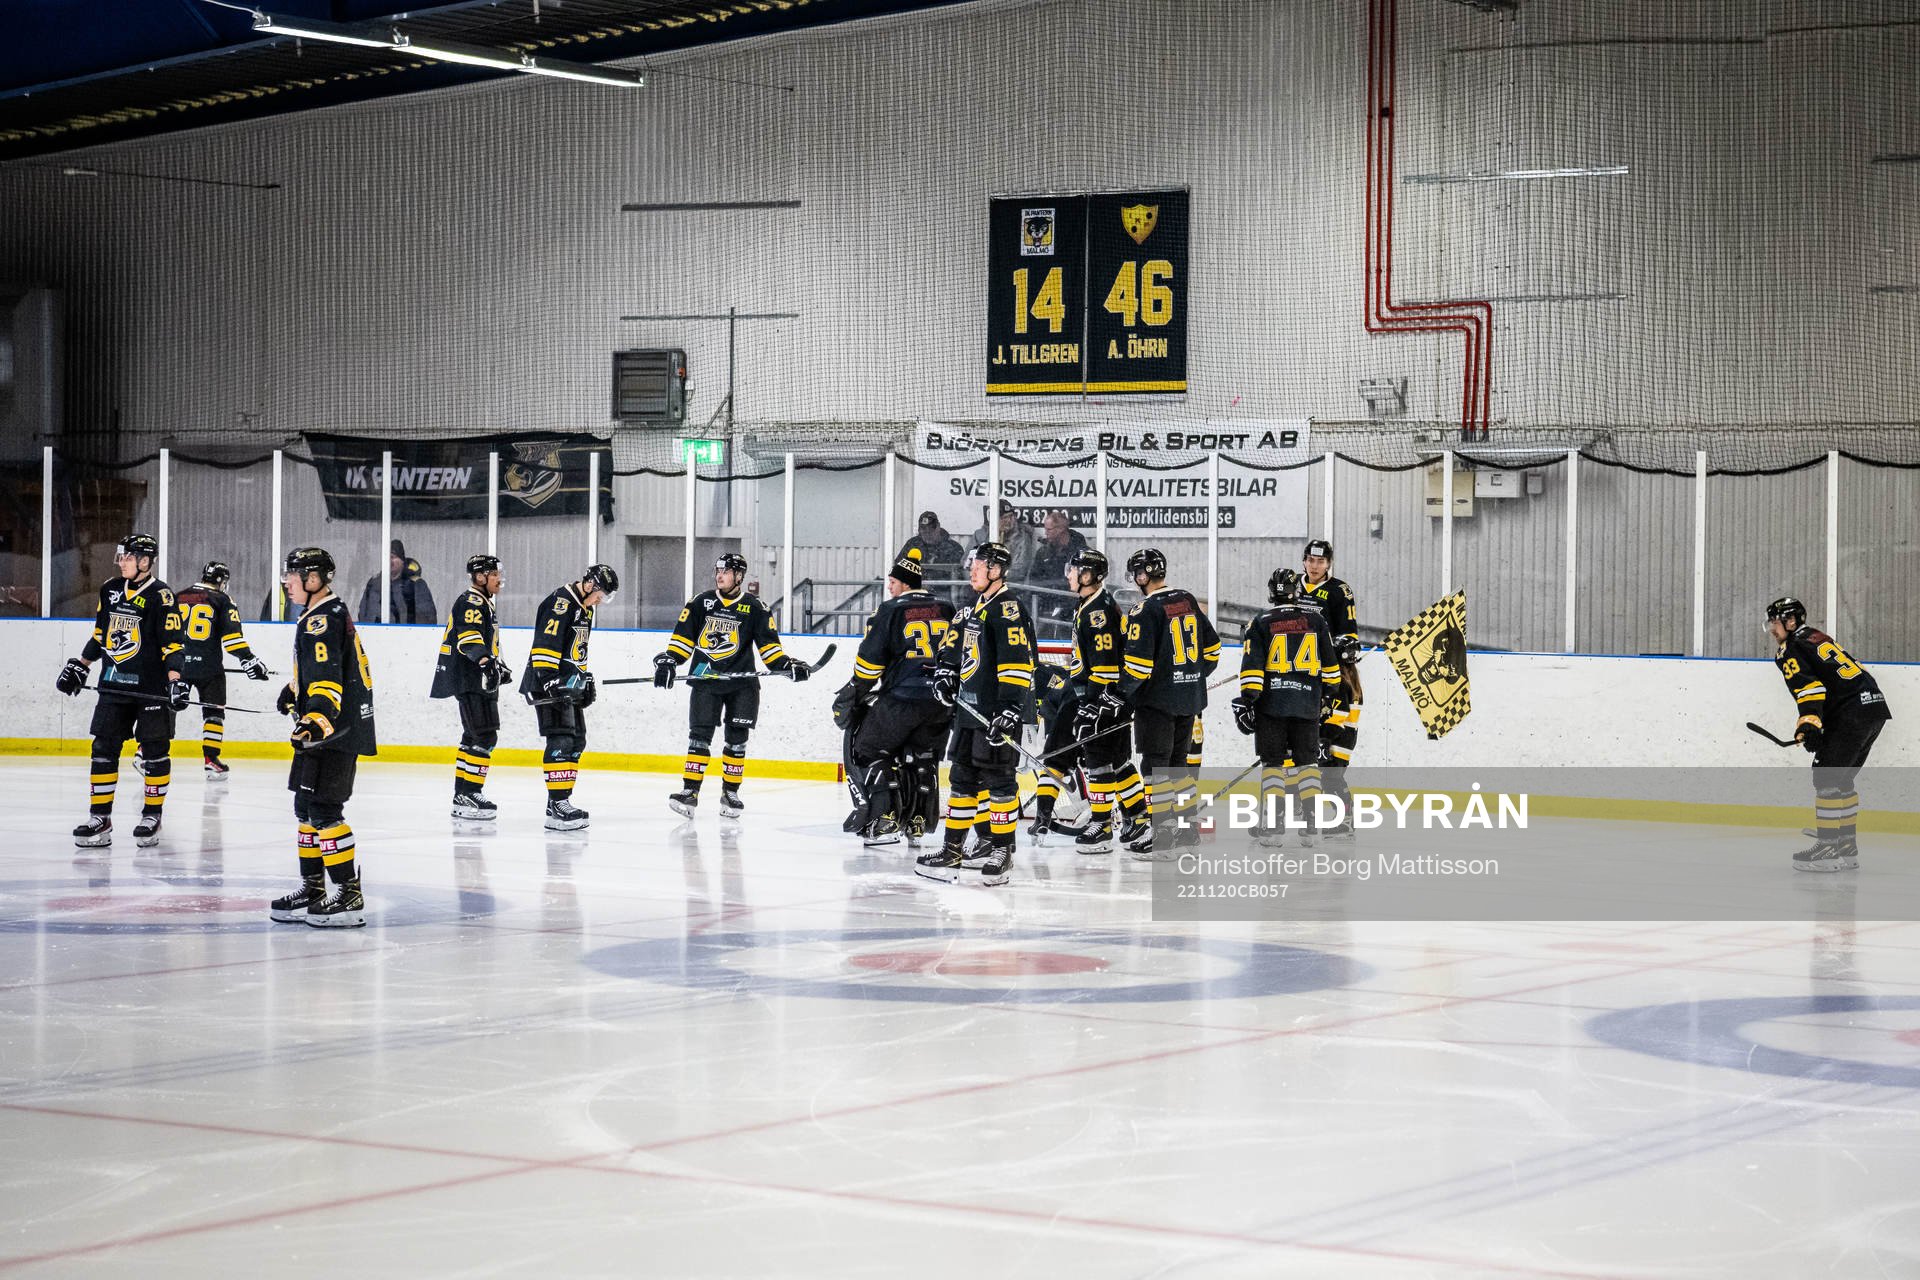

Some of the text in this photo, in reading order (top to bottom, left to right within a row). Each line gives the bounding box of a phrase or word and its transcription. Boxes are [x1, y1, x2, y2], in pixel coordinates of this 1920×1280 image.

[1013, 267, 1065, 334] 14
[1103, 260, 1174, 326] 46
[993, 343, 1079, 365] J. TILLGREN
[1107, 333, 1168, 359] A. ÖHRN
[1099, 432, 1136, 451] BIL
[1140, 432, 1159, 451] &
[1165, 432, 1250, 450] SPORT
[1257, 430, 1299, 449] AB
[1067, 458, 1147, 468] STAFFNSTORP
[1106, 477, 1278, 497] KVALITETSBILAR
[1081, 508, 1233, 528] ww.bjorklidensbise
[165, 613, 181, 631] 50
[464, 609, 483, 625] 92
[543, 618, 559, 636] 21
[903, 620, 949, 659] 37
[1094, 633, 1113, 652] 39
[1169, 614, 1199, 666] 13
[314, 641, 328, 663] 8
[1265, 632, 1322, 677] 44
[1782, 657, 1801, 680] 33
[1395, 658, 1432, 709] MALMÖ
